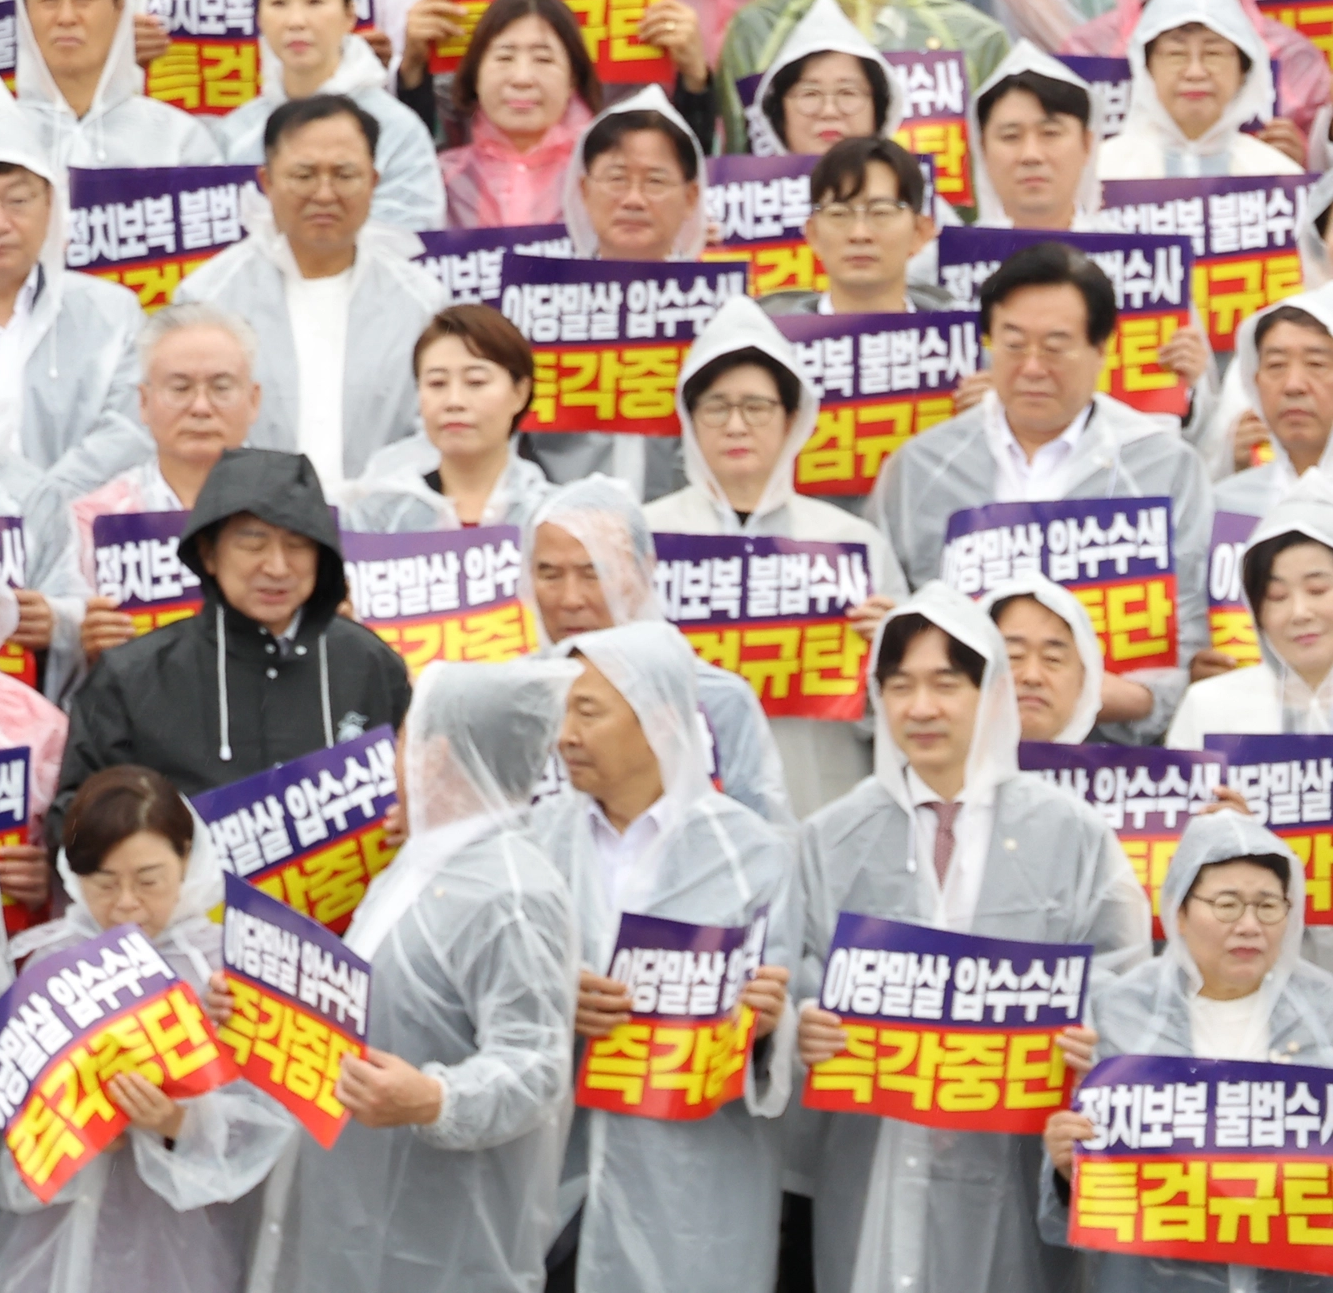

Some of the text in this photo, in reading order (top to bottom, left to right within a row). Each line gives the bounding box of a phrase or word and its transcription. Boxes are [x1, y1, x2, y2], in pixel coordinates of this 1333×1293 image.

[149, 44, 261, 107] 특검
[66, 195, 175, 267] 정치보복
[503, 284, 622, 340] 야당말살
[859, 324, 978, 390] 불법수사
[95, 538, 200, 604] 정치보
[1047, 507, 1167, 581] 압수수색
[343, 554, 460, 618] 야당말살
[655, 550, 869, 621] 치보복 불법수사
[285, 737, 397, 858] 압수수색
[49, 930, 175, 1028] 압수수색
[224, 907, 369, 1036] 야당말살 압수수색
[609, 947, 725, 1016] 야당말살
[824, 947, 1085, 1023] 야당말살 압수수색
[8, 990, 209, 1185] 즉각중단
[219, 982, 364, 1121] 즉각중단
[812, 1026, 1065, 1112] 즉각중단
[1079, 1078, 1207, 1149] 정치보복
